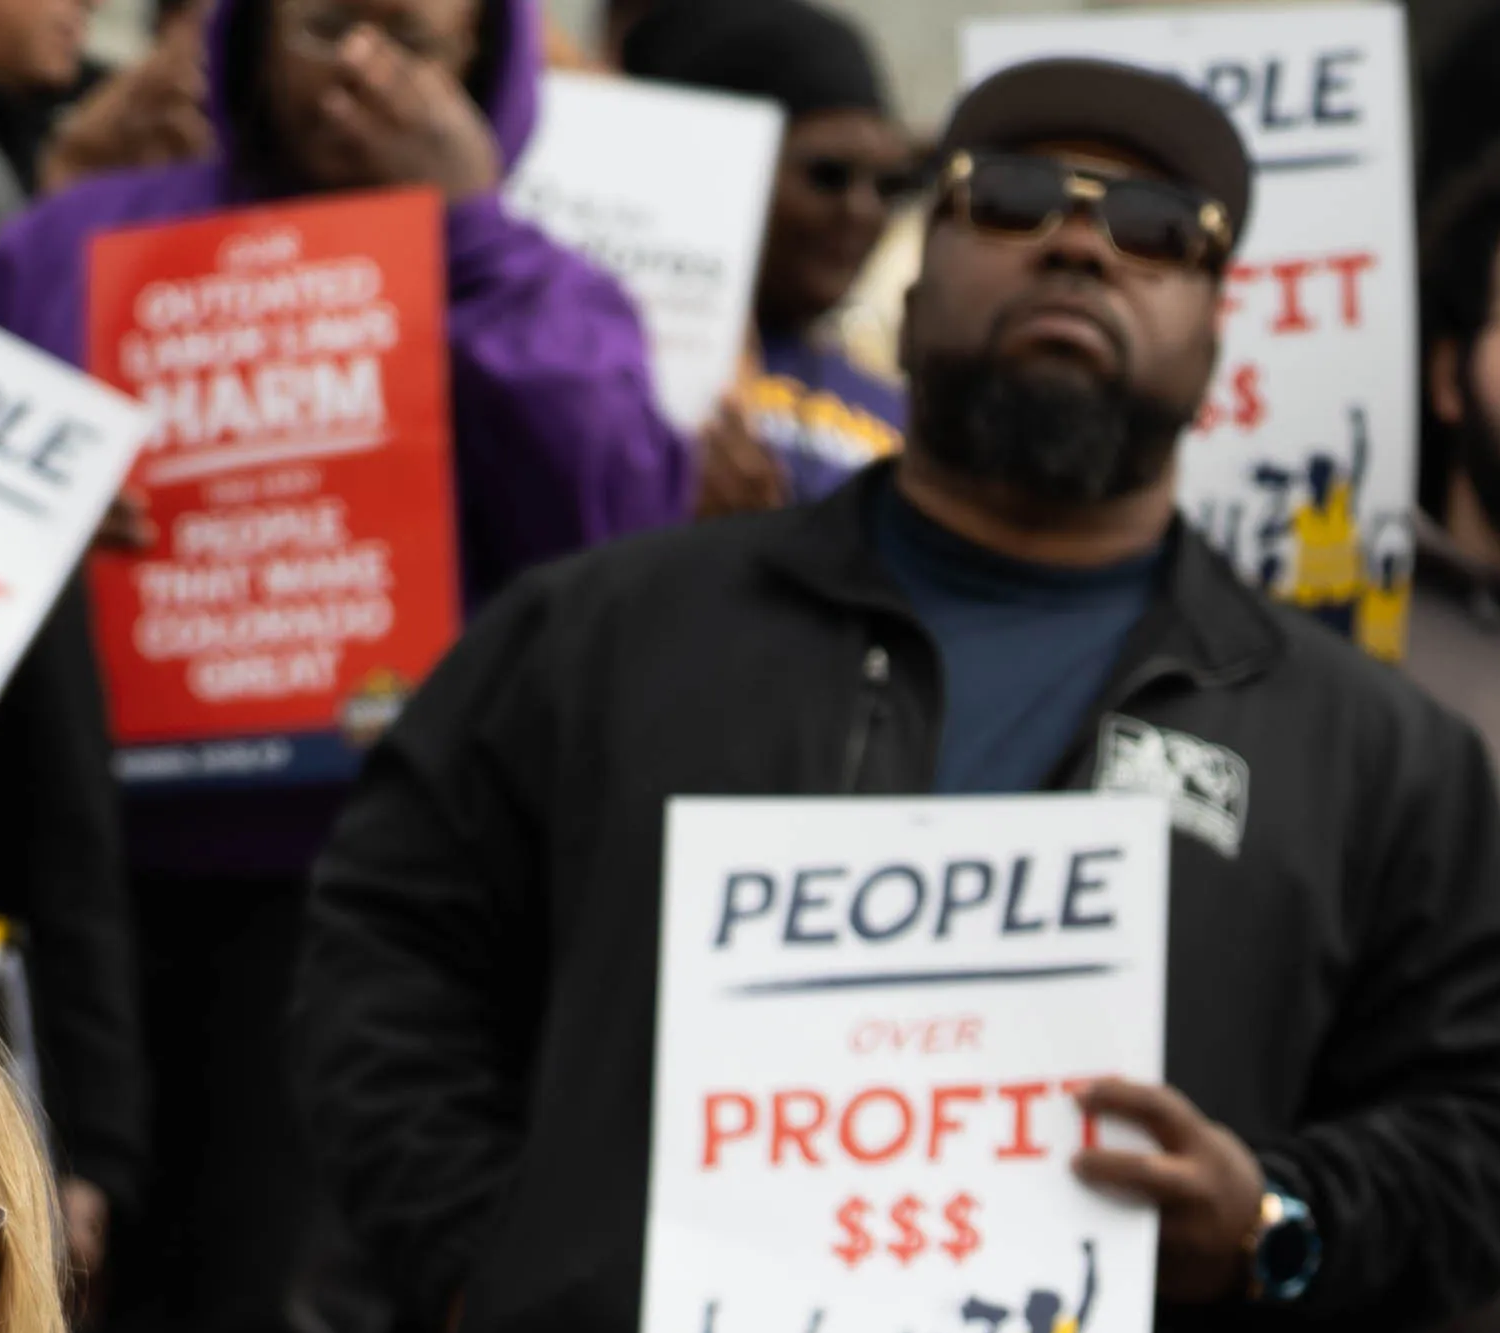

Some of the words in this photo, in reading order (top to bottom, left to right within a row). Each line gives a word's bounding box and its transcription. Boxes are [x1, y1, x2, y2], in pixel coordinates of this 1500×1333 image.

[141, 353, 384, 450] HARM
[712, 846, 1126, 950] PEOPLE
[849, 1016, 985, 1055] OVER
[831, 1191, 980, 1267] $$$
